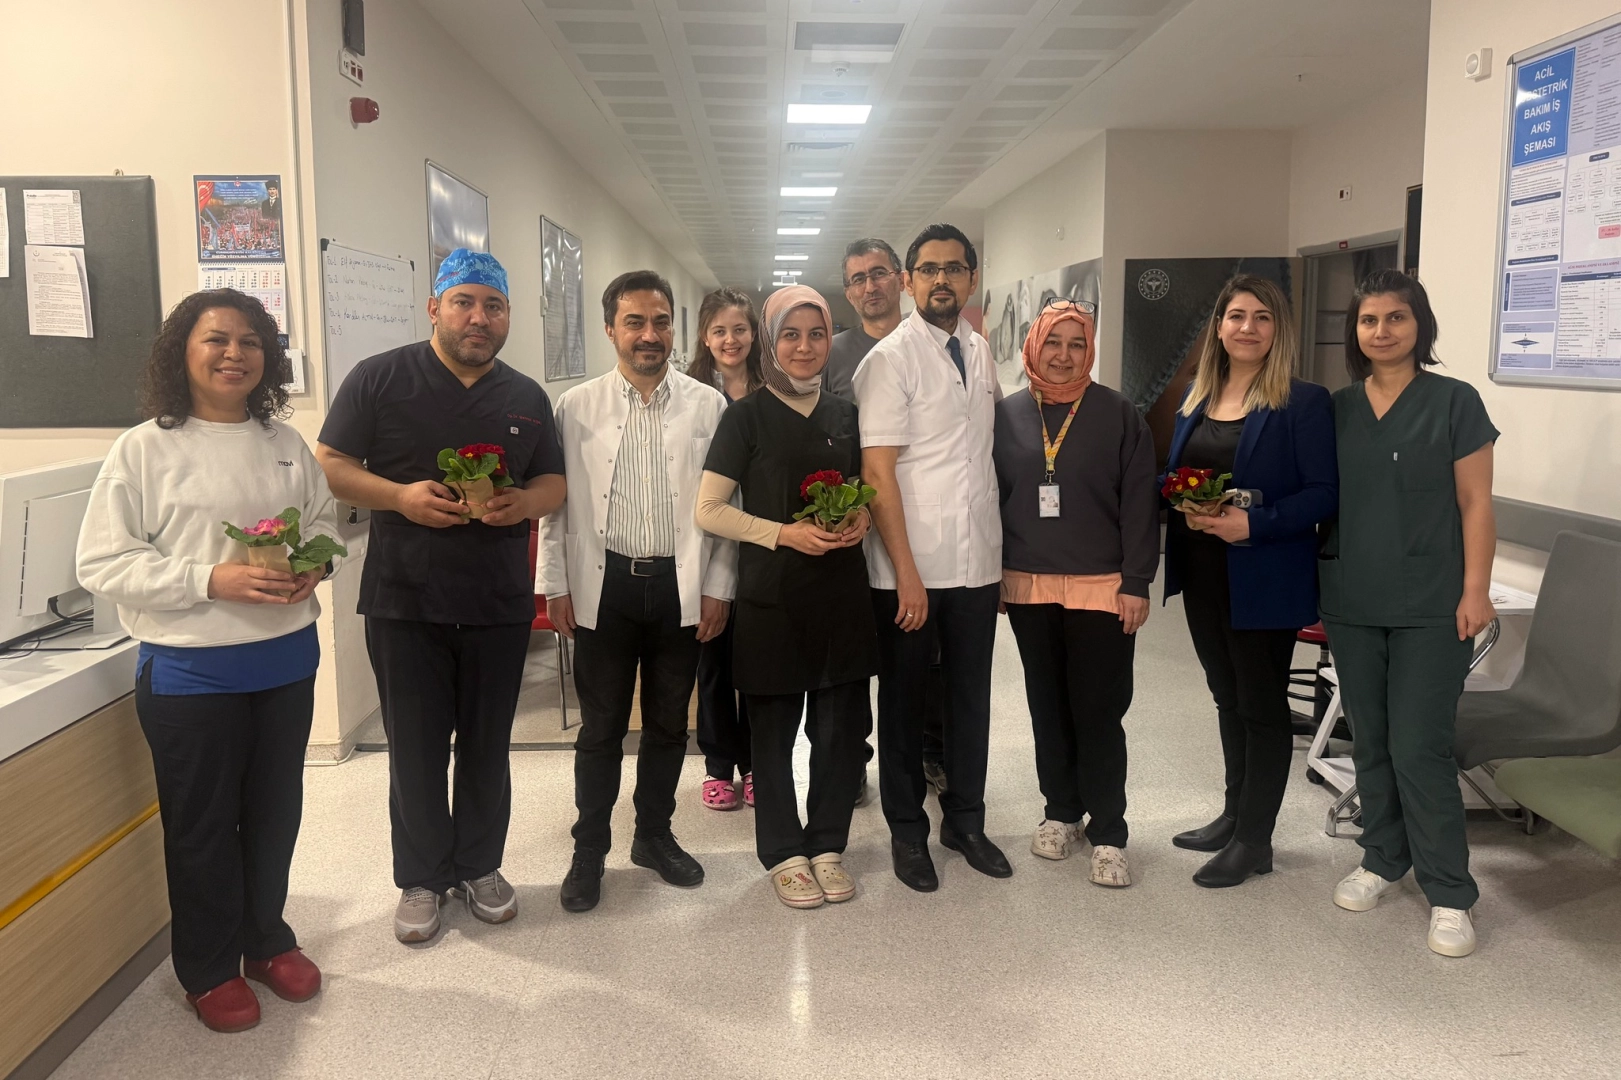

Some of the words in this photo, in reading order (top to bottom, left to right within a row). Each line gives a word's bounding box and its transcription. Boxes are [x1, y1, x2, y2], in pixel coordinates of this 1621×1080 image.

[1535, 65, 1554, 81] ACİL
[1524, 102, 1550, 119] BAKIM
[1552, 99, 1560, 112] İŞ
[1530, 120, 1551, 135] AKIŞ
[1524, 136, 1556, 156] ŞEMASI
